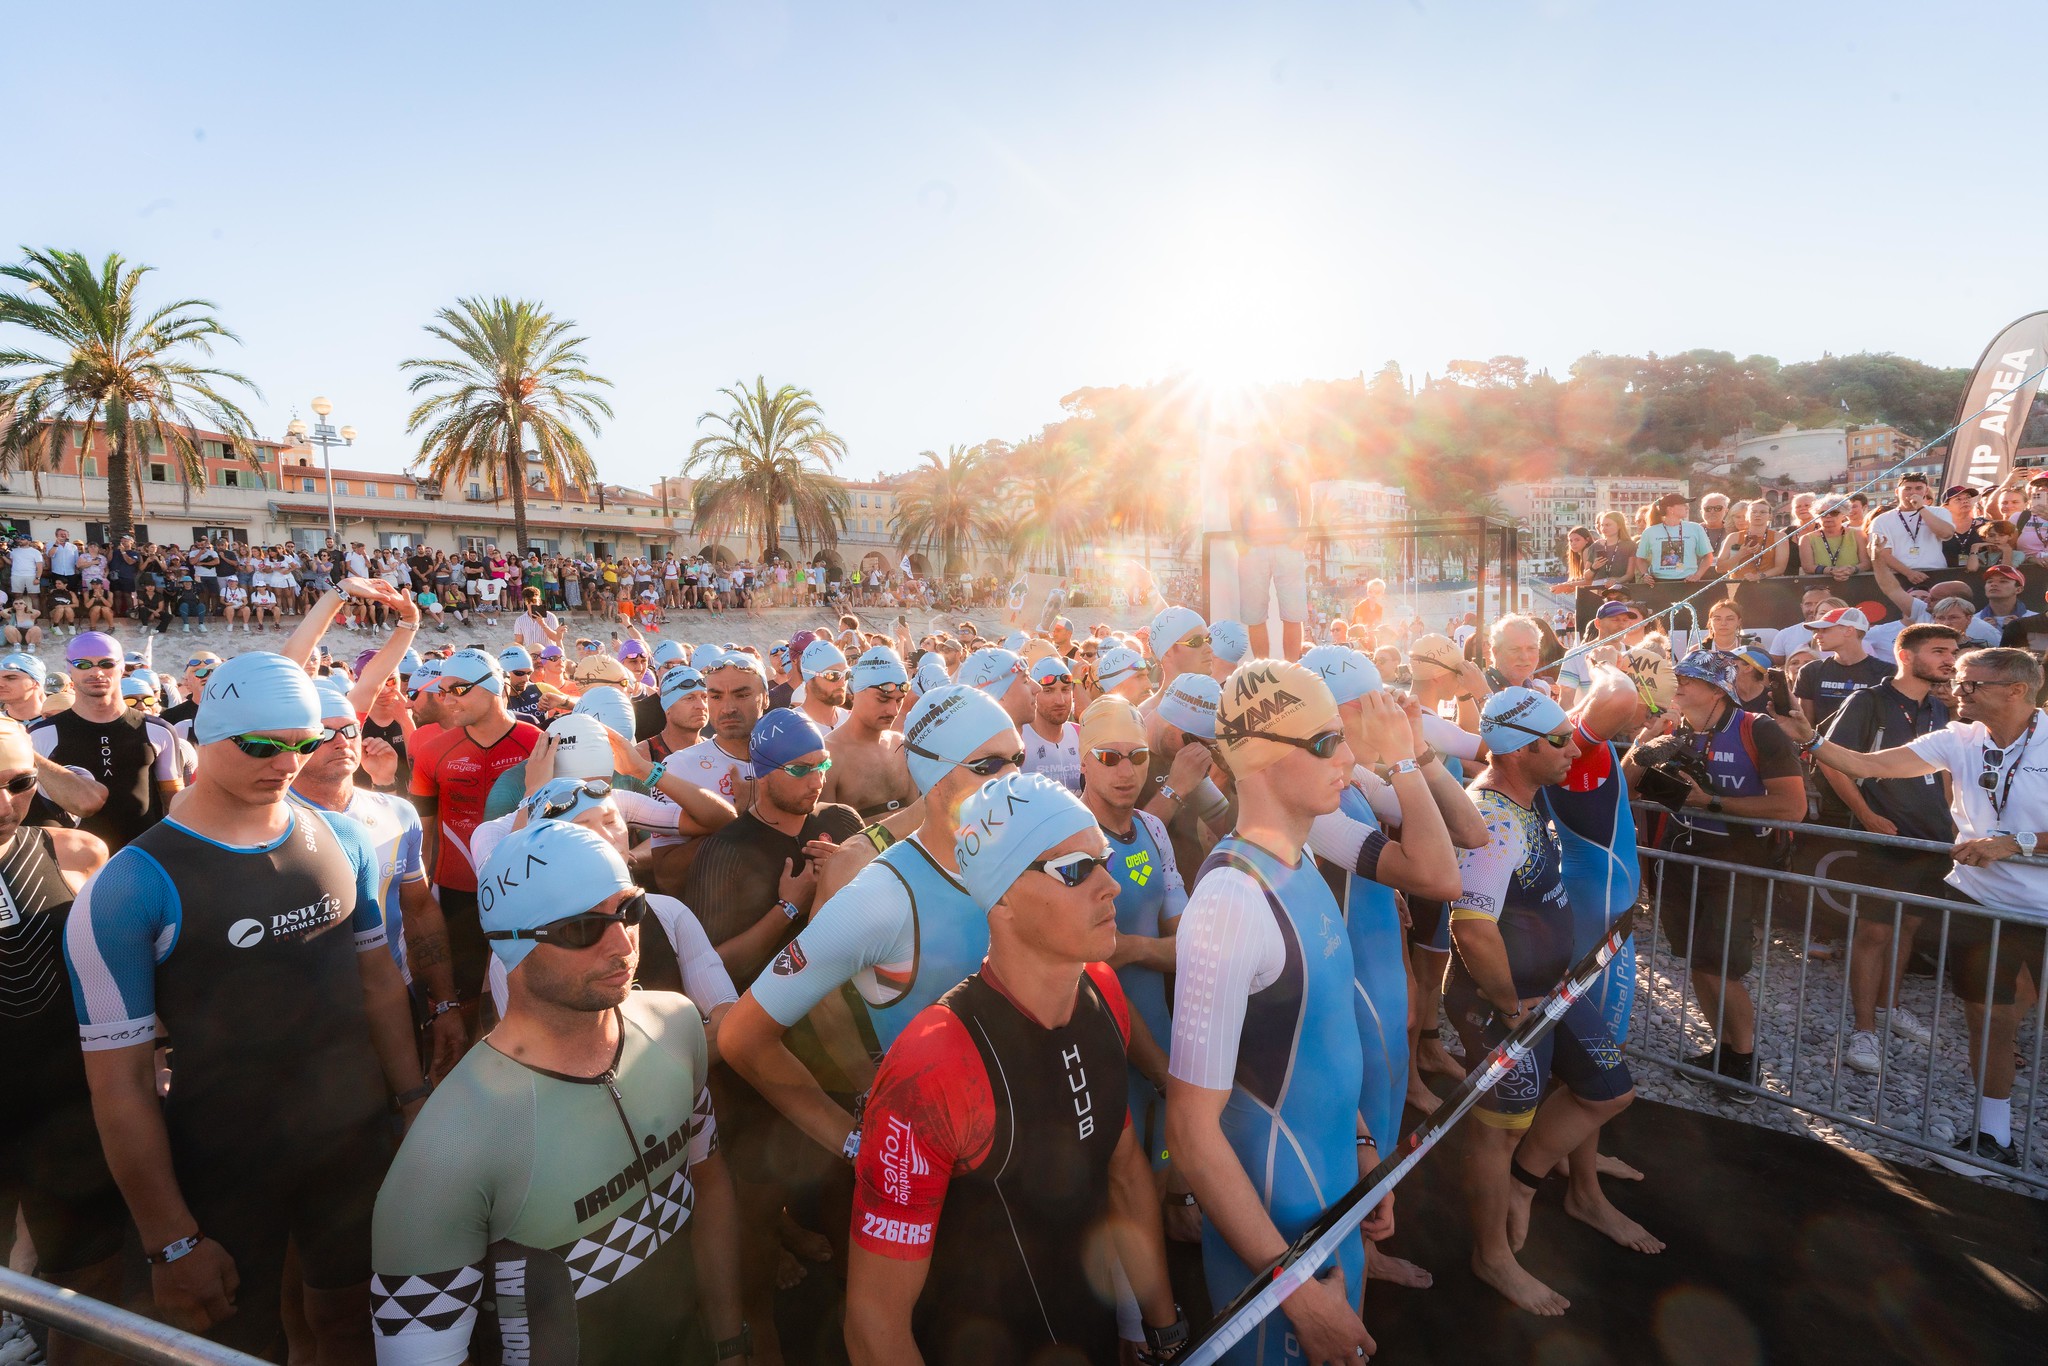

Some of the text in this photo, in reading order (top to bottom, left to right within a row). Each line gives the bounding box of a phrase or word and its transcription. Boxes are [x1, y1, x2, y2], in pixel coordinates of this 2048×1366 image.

[1966, 348, 2035, 489] VIP AREA
[907, 693, 965, 743] IRONMAN
[950, 700, 968, 715] NICE
[1174, 689, 1218, 710] IRONMAN
[1718, 774, 1745, 789] TV
[1125, 850, 1149, 869] arena
[273, 911, 342, 936] DARMSTADT
[1062, 1044, 1094, 1140] HUUB
[574, 1117, 691, 1224] IRONMAN
[880, 1115, 911, 1200] Troyes
[862, 1212, 932, 1245] 226ERS
[494, 1259, 530, 1366] RONMAN
